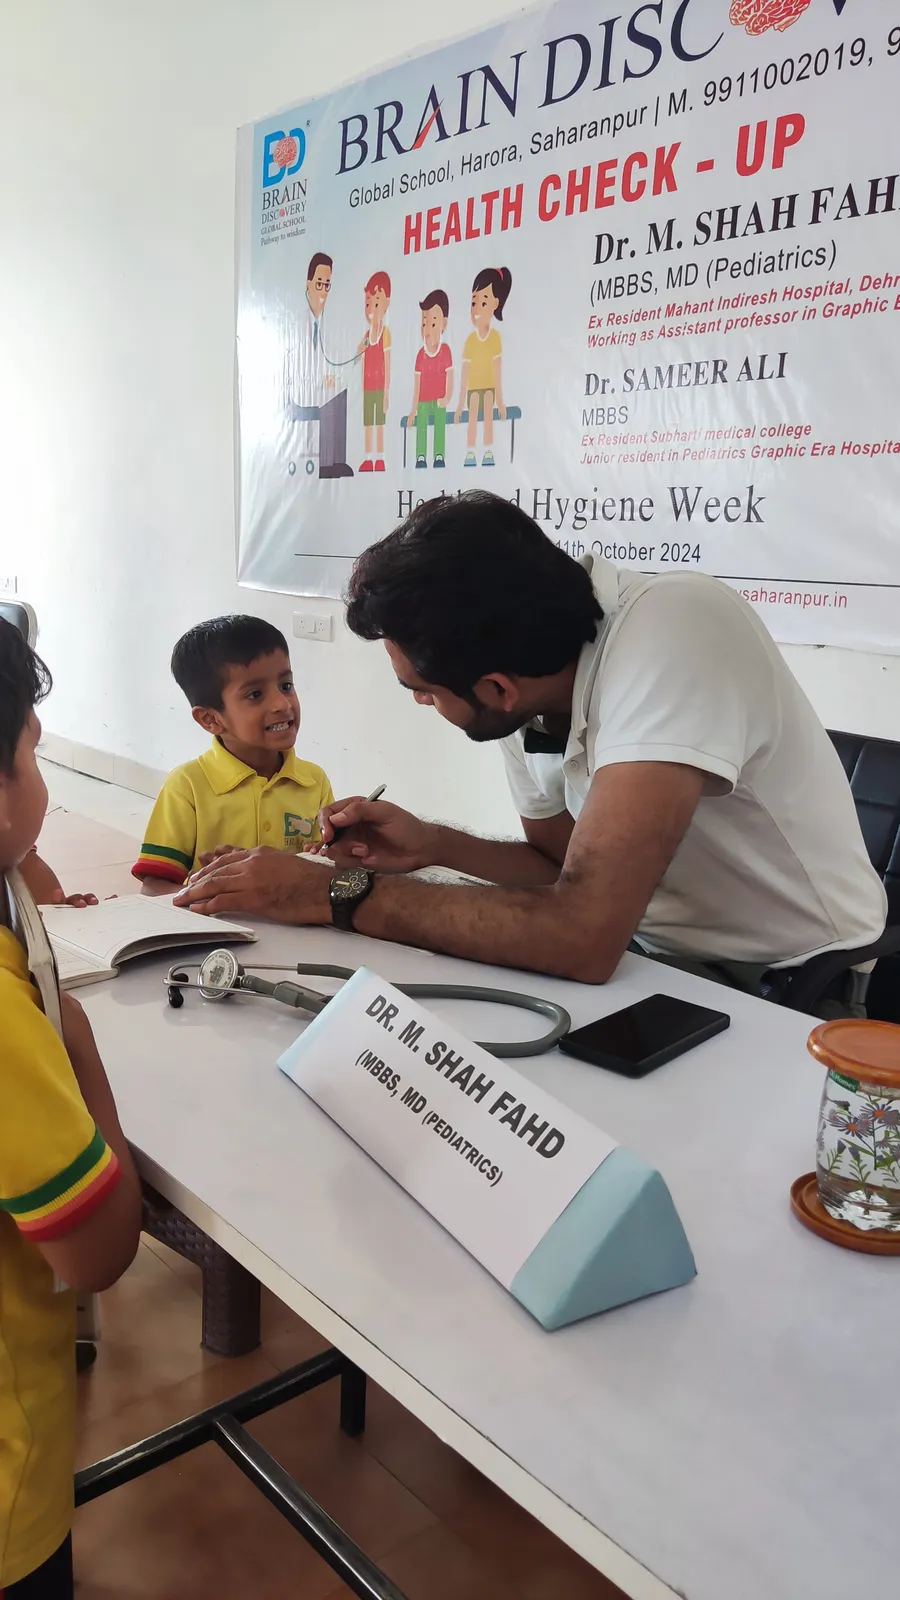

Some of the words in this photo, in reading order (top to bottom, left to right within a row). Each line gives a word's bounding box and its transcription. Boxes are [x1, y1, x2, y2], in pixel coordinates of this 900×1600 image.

[335, 50, 528, 176] BRAIN
[349, 178, 395, 208] Global
[400, 160, 455, 194] School,
[461, 144, 523, 177] Harora,
[530, 105, 648, 155] Saharanpur
[667, 88, 693, 118] M.
[703, 37, 873, 106] 9911002019,
[262, 178, 308, 211] BRAIN
[404, 183, 524, 256] HEALTH
[538, 141, 682, 222] CHECK
[735, 113, 806, 177] UP
[260, 222, 283, 236] GLOBAL
[282, 215, 307, 229] SCHOOL
[286, 227, 306, 239] wisdom
[592, 232, 636, 265] Dr.
[645, 218, 683, 254] M.
[692, 193, 800, 247] SHAH
[807, 174, 900, 226] FAH
[590, 270, 659, 307] (MBBS,
[666, 262, 699, 290] MD
[706, 239, 837, 288] (Pediatrics)
[587, 331, 637, 348] Working
[639, 327, 654, 341] as
[657, 317, 722, 340] Assistant
[724, 309, 798, 334] professor
[801, 305, 817, 321] in
[822, 296, 889, 320] Graphic
[588, 315, 603, 330] Ex
[606, 307, 662, 328] Resident
[664, 298, 715, 319] Mahant
[717, 288, 778, 311] Indiresh
[782, 277, 854, 302] Hospital,
[583, 372, 616, 396] Dr.
[622, 358, 729, 394] SAMEER
[735, 351, 789, 382] ALI
[581, 405, 629, 427] MBBS
[581, 434, 595, 447] Ex
[597, 432, 648, 446] Resident
[650, 427, 703, 444] Subharti
[704, 424, 756, 441] medical
[759, 423, 812, 440] college
[580, 452, 615, 465] Junior
[617, 449, 666, 463] resident
[668, 449, 679, 462] in
[682, 446, 747, 461] Pediatrics
[750, 443, 807, 461] Graphic
[810, 442, 836, 457] Era
[532, 486, 655, 532] Hygiene
[667, 485, 767, 524] Week
[591, 540, 655, 561] October
[660, 542, 701, 563] 2024
[365, 994, 400, 1033] DR.
[397, 1019, 425, 1053] M.
[424, 1041, 495, 1104] SHAH
[488, 1091, 566, 1159] FAHD
[354, 1048, 401, 1098] (MBBS,
[400, 1086, 428, 1114] MD
[421, 1110, 504, 1188] (PEDIATRICS)
